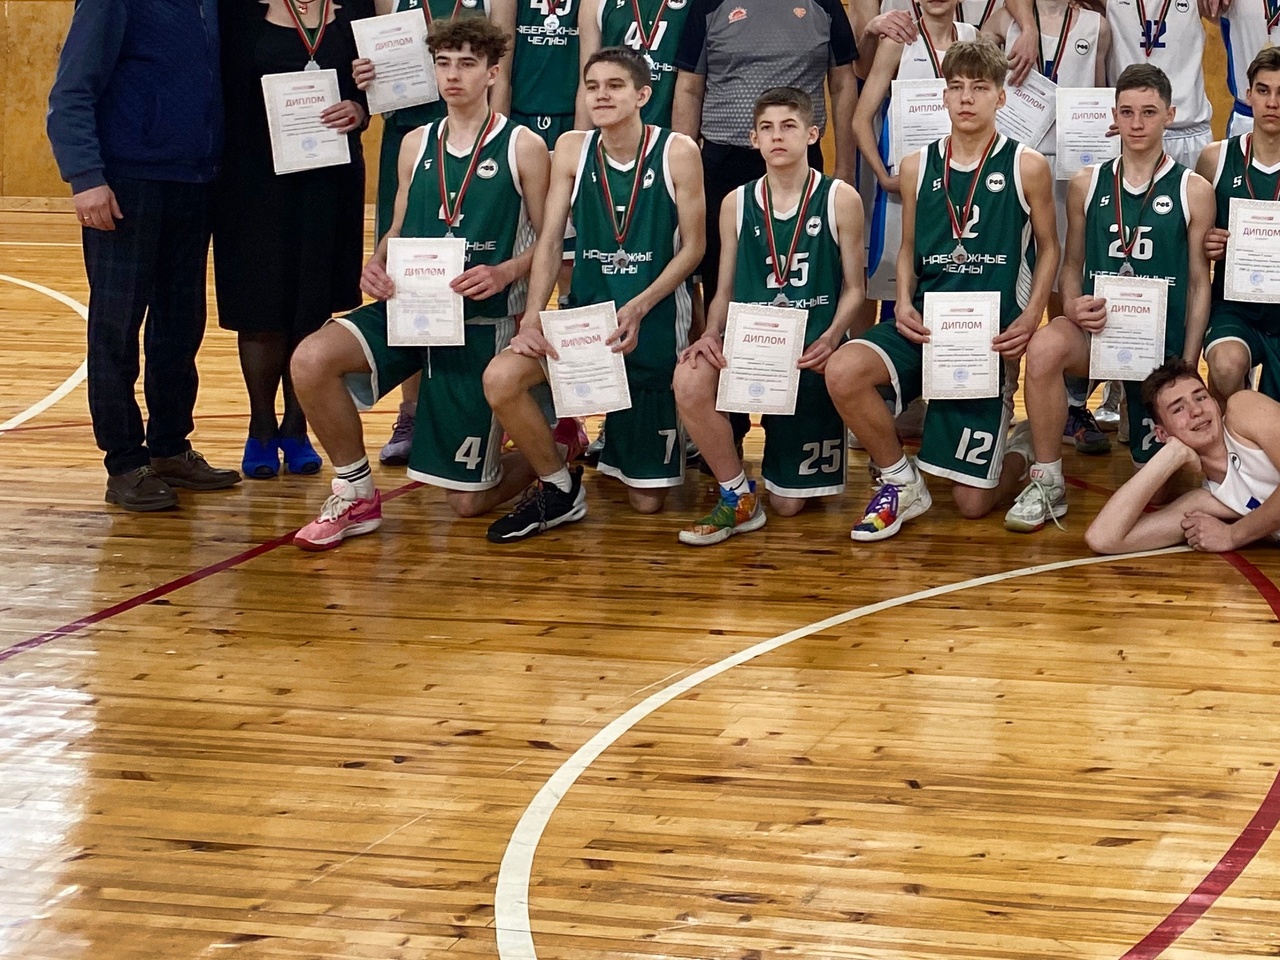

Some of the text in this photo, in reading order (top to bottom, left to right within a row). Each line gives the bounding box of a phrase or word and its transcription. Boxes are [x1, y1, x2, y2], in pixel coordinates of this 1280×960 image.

[375, 36, 414, 51] ДИПЛОМ
[285, 95, 326, 108] ДИПЛОМ
[1013, 88, 1046, 112] ДИПЛОМ
[908, 103, 946, 113] ДИПЛОМ
[1071, 112, 1107, 121] ДИПЛОМ
[1108, 224, 1153, 261] 26
[404, 267, 446, 277] ДИПЛОМ
[765, 252, 810, 289] 25
[1110, 304, 1151, 314] ДИПЛОМ
[941, 321, 982, 331] ДИПЛОМ
[561, 334, 602, 348] ДИПЛОМ
[742, 334, 787, 345] ДИПЛОМ
[455, 436, 482, 470] 4
[658, 429, 677, 465] 7
[954, 427, 994, 465] 12
[799, 439, 842, 476] 25
